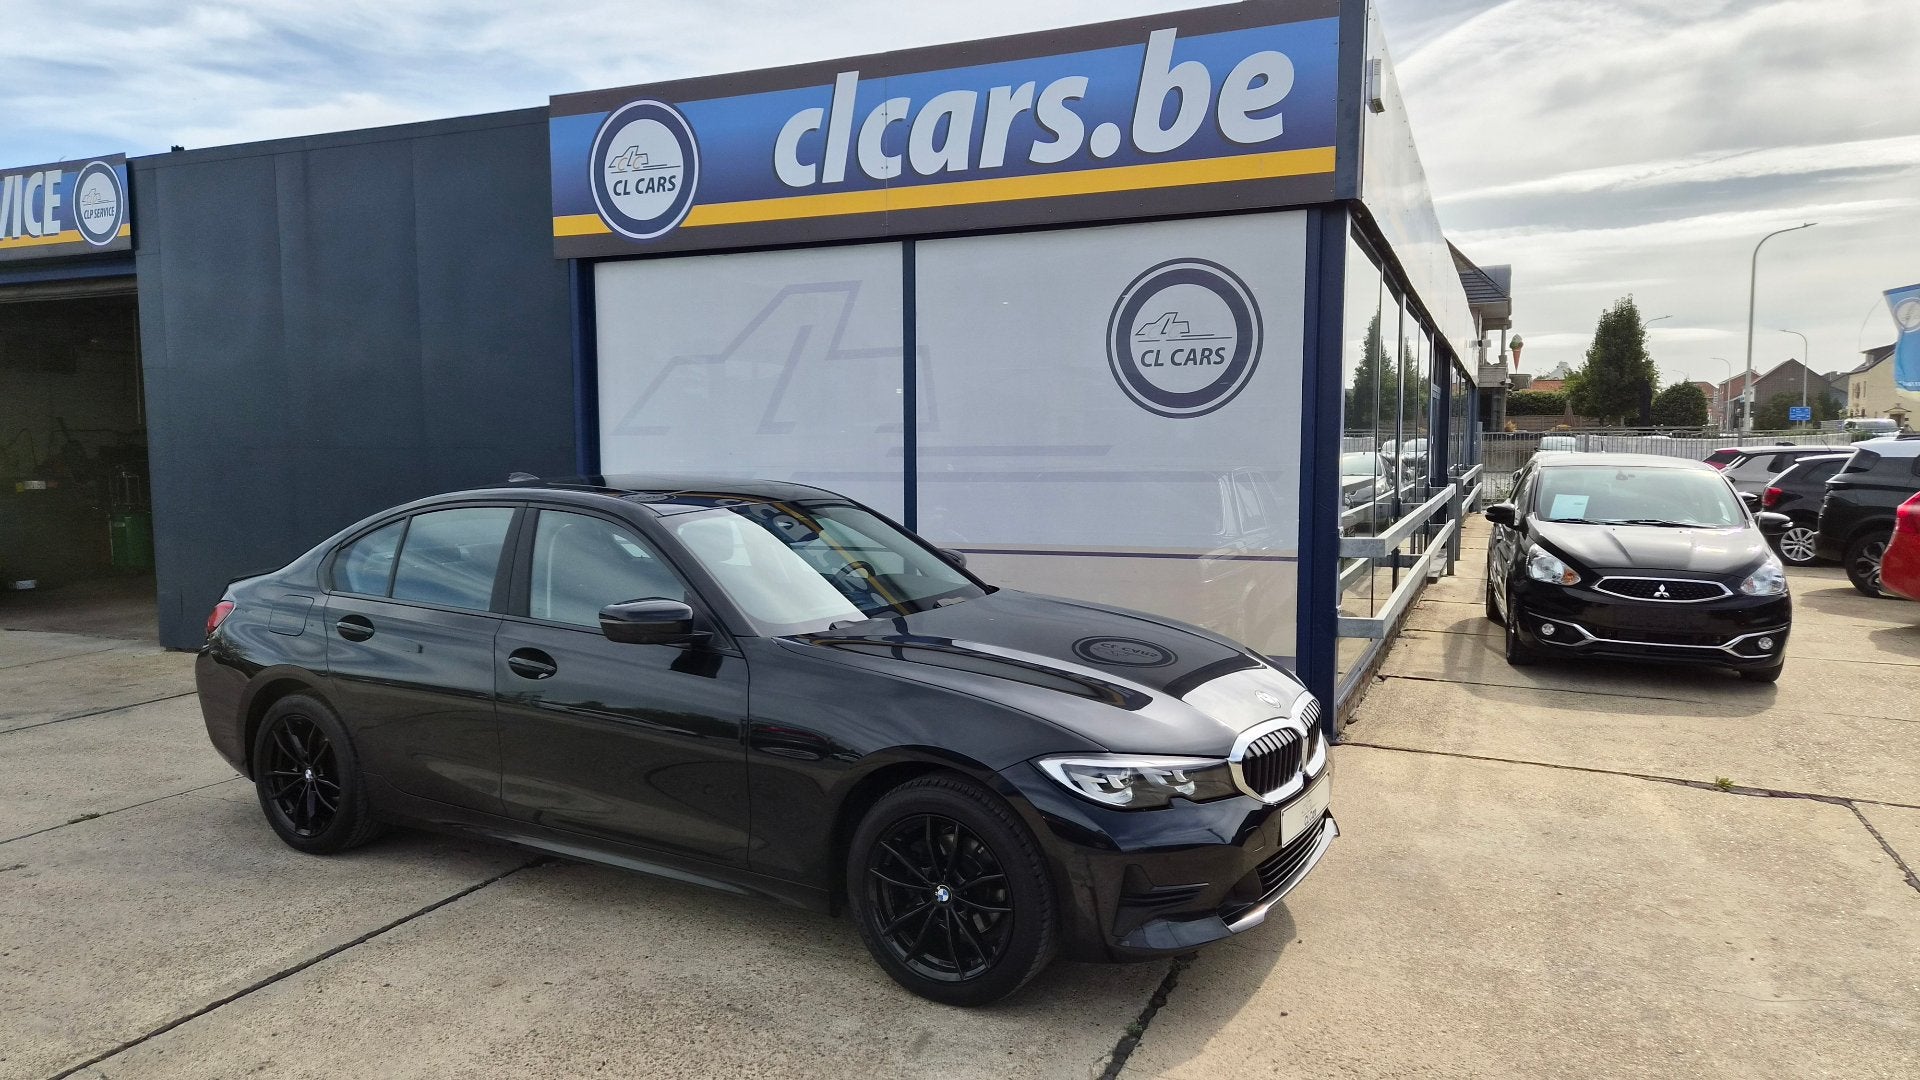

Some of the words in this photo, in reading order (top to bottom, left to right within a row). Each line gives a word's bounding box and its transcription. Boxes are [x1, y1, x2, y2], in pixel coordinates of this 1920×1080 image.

[774, 27, 1295, 187] clcars.be
[613, 180, 630, 196] CL
[635, 175, 677, 194] CARS
[84, 209, 94, 219] CLP
[94, 206, 115, 218] SERVICE
[1140, 350, 1164, 367] CL
[1170, 347, 1226, 366] CARS
